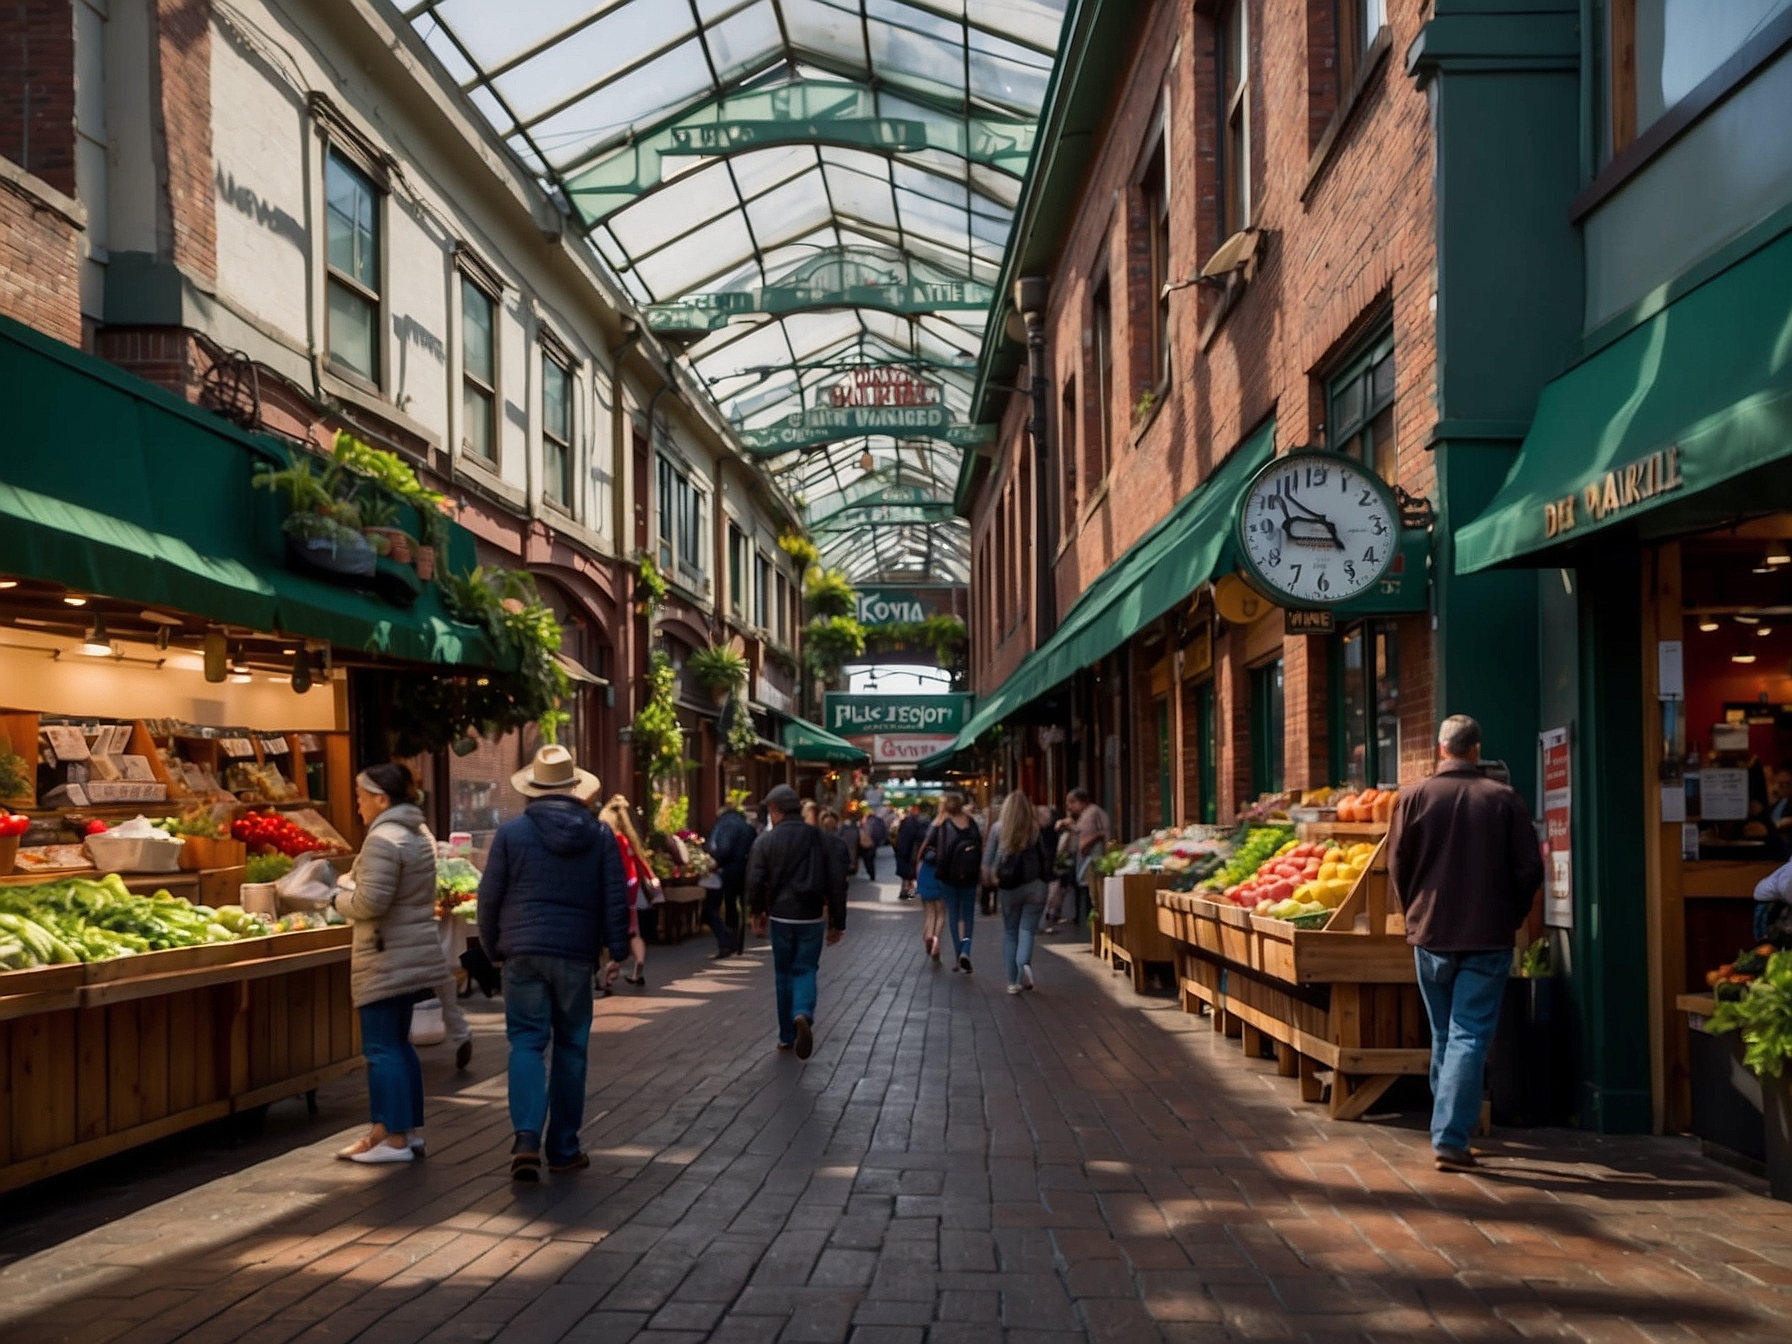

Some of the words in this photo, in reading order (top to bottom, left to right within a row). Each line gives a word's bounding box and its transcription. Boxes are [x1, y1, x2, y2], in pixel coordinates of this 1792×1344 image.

[1358, 489, 1372, 507] 2
[1362, 546, 1379, 564] 4
[1290, 564, 1302, 584] 7
[1317, 571, 1330, 592] 6
